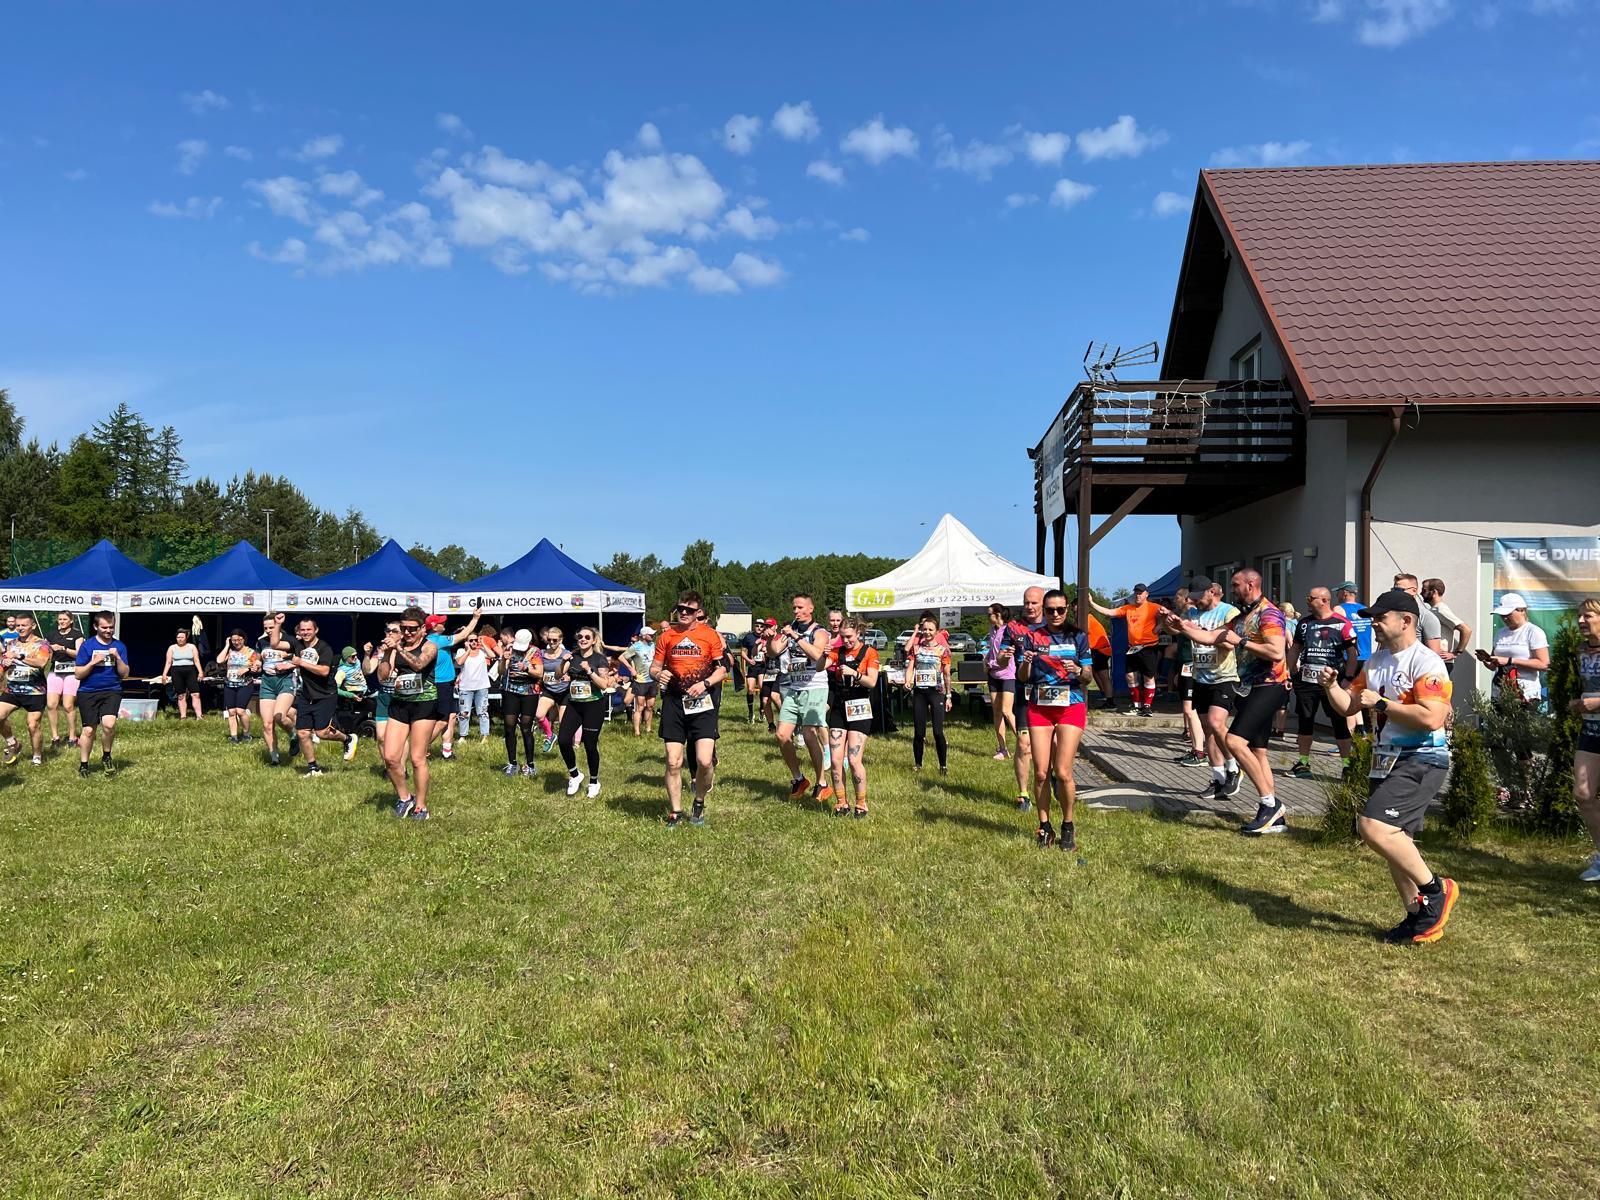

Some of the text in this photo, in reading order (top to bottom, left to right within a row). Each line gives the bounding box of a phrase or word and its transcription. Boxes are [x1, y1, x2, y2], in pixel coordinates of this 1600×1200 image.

[1, 594, 84, 605] GMINA CHOCZEWO
[149, 596, 236, 606] GMINA CHOCZEWO
[306, 596, 398, 607] GMINA CHOCZEWO
[505, 598, 564, 608] CHOCZEWO
[857, 592, 891, 606] G.M.
[984, 594, 996, 602] 39
[1196, 654, 1213, 663] 109
[400, 680, 417, 690] 180
[1045, 688, 1060, 700] 43
